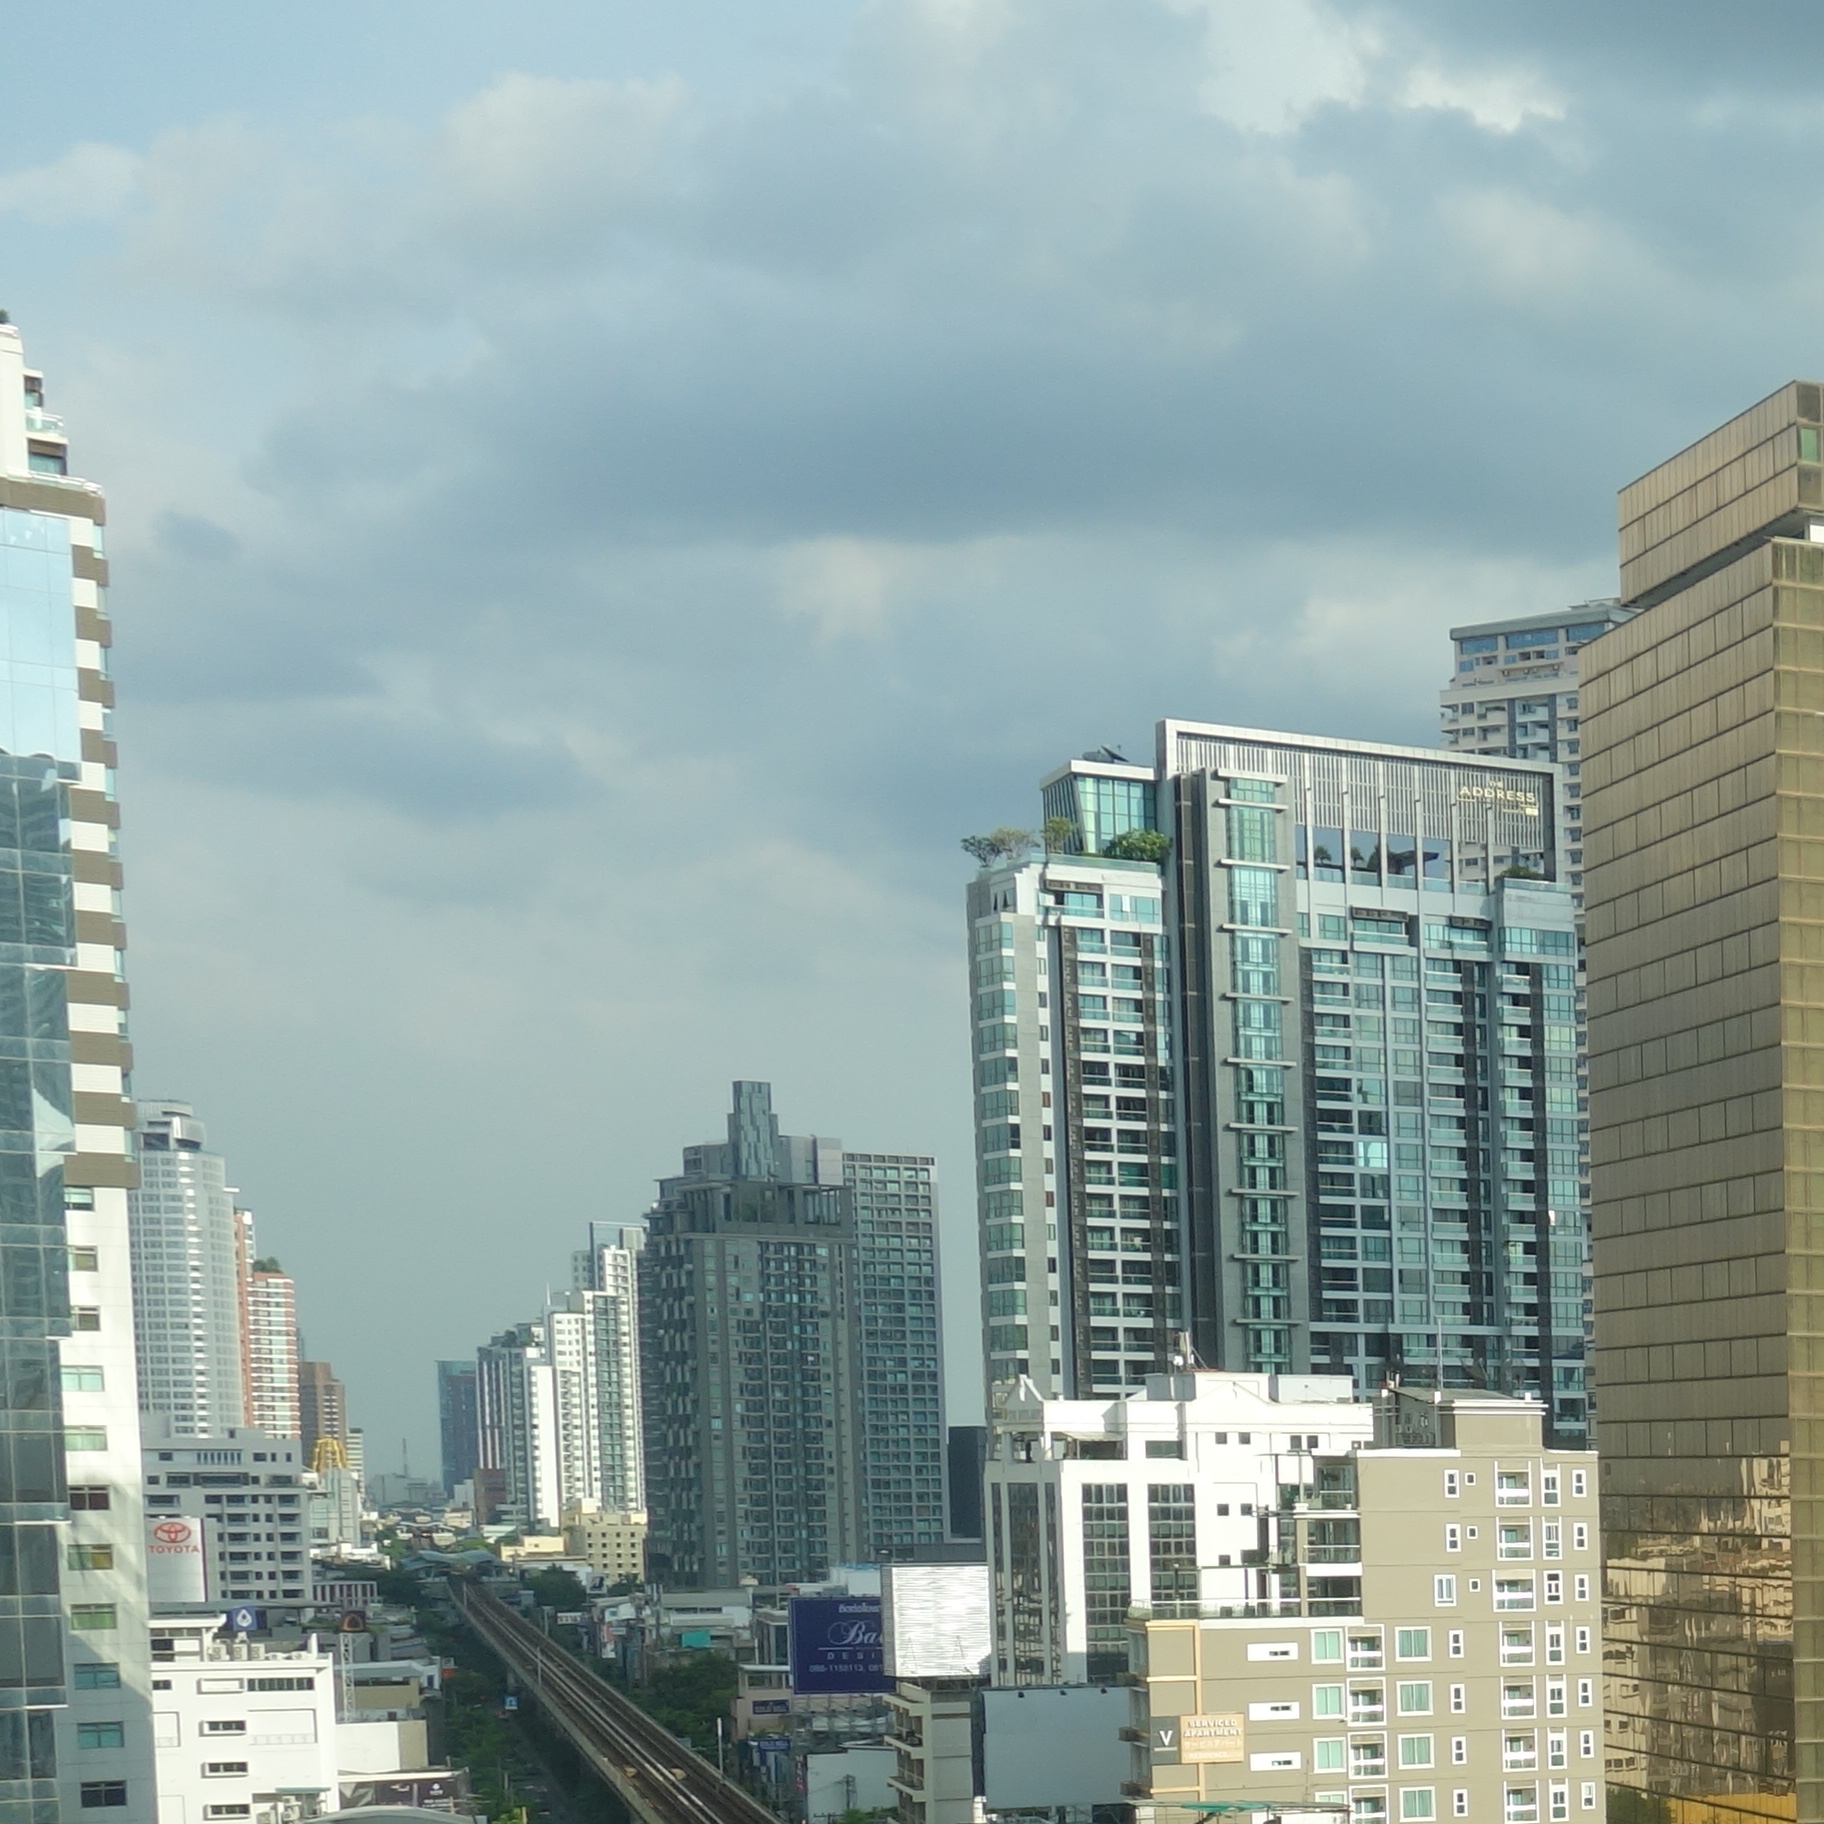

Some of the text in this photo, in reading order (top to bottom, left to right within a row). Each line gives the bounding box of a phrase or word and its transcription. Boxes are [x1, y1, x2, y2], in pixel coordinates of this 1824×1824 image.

[1460, 786, 1535, 802] ADDRESS
[148, 1544, 200, 1553] TOYOTA
[1188, 1719, 1237, 1728] SERVICED
[1159, 1730, 1173, 1746] V
[1183, 1728, 1243, 1738] APARTMENT
